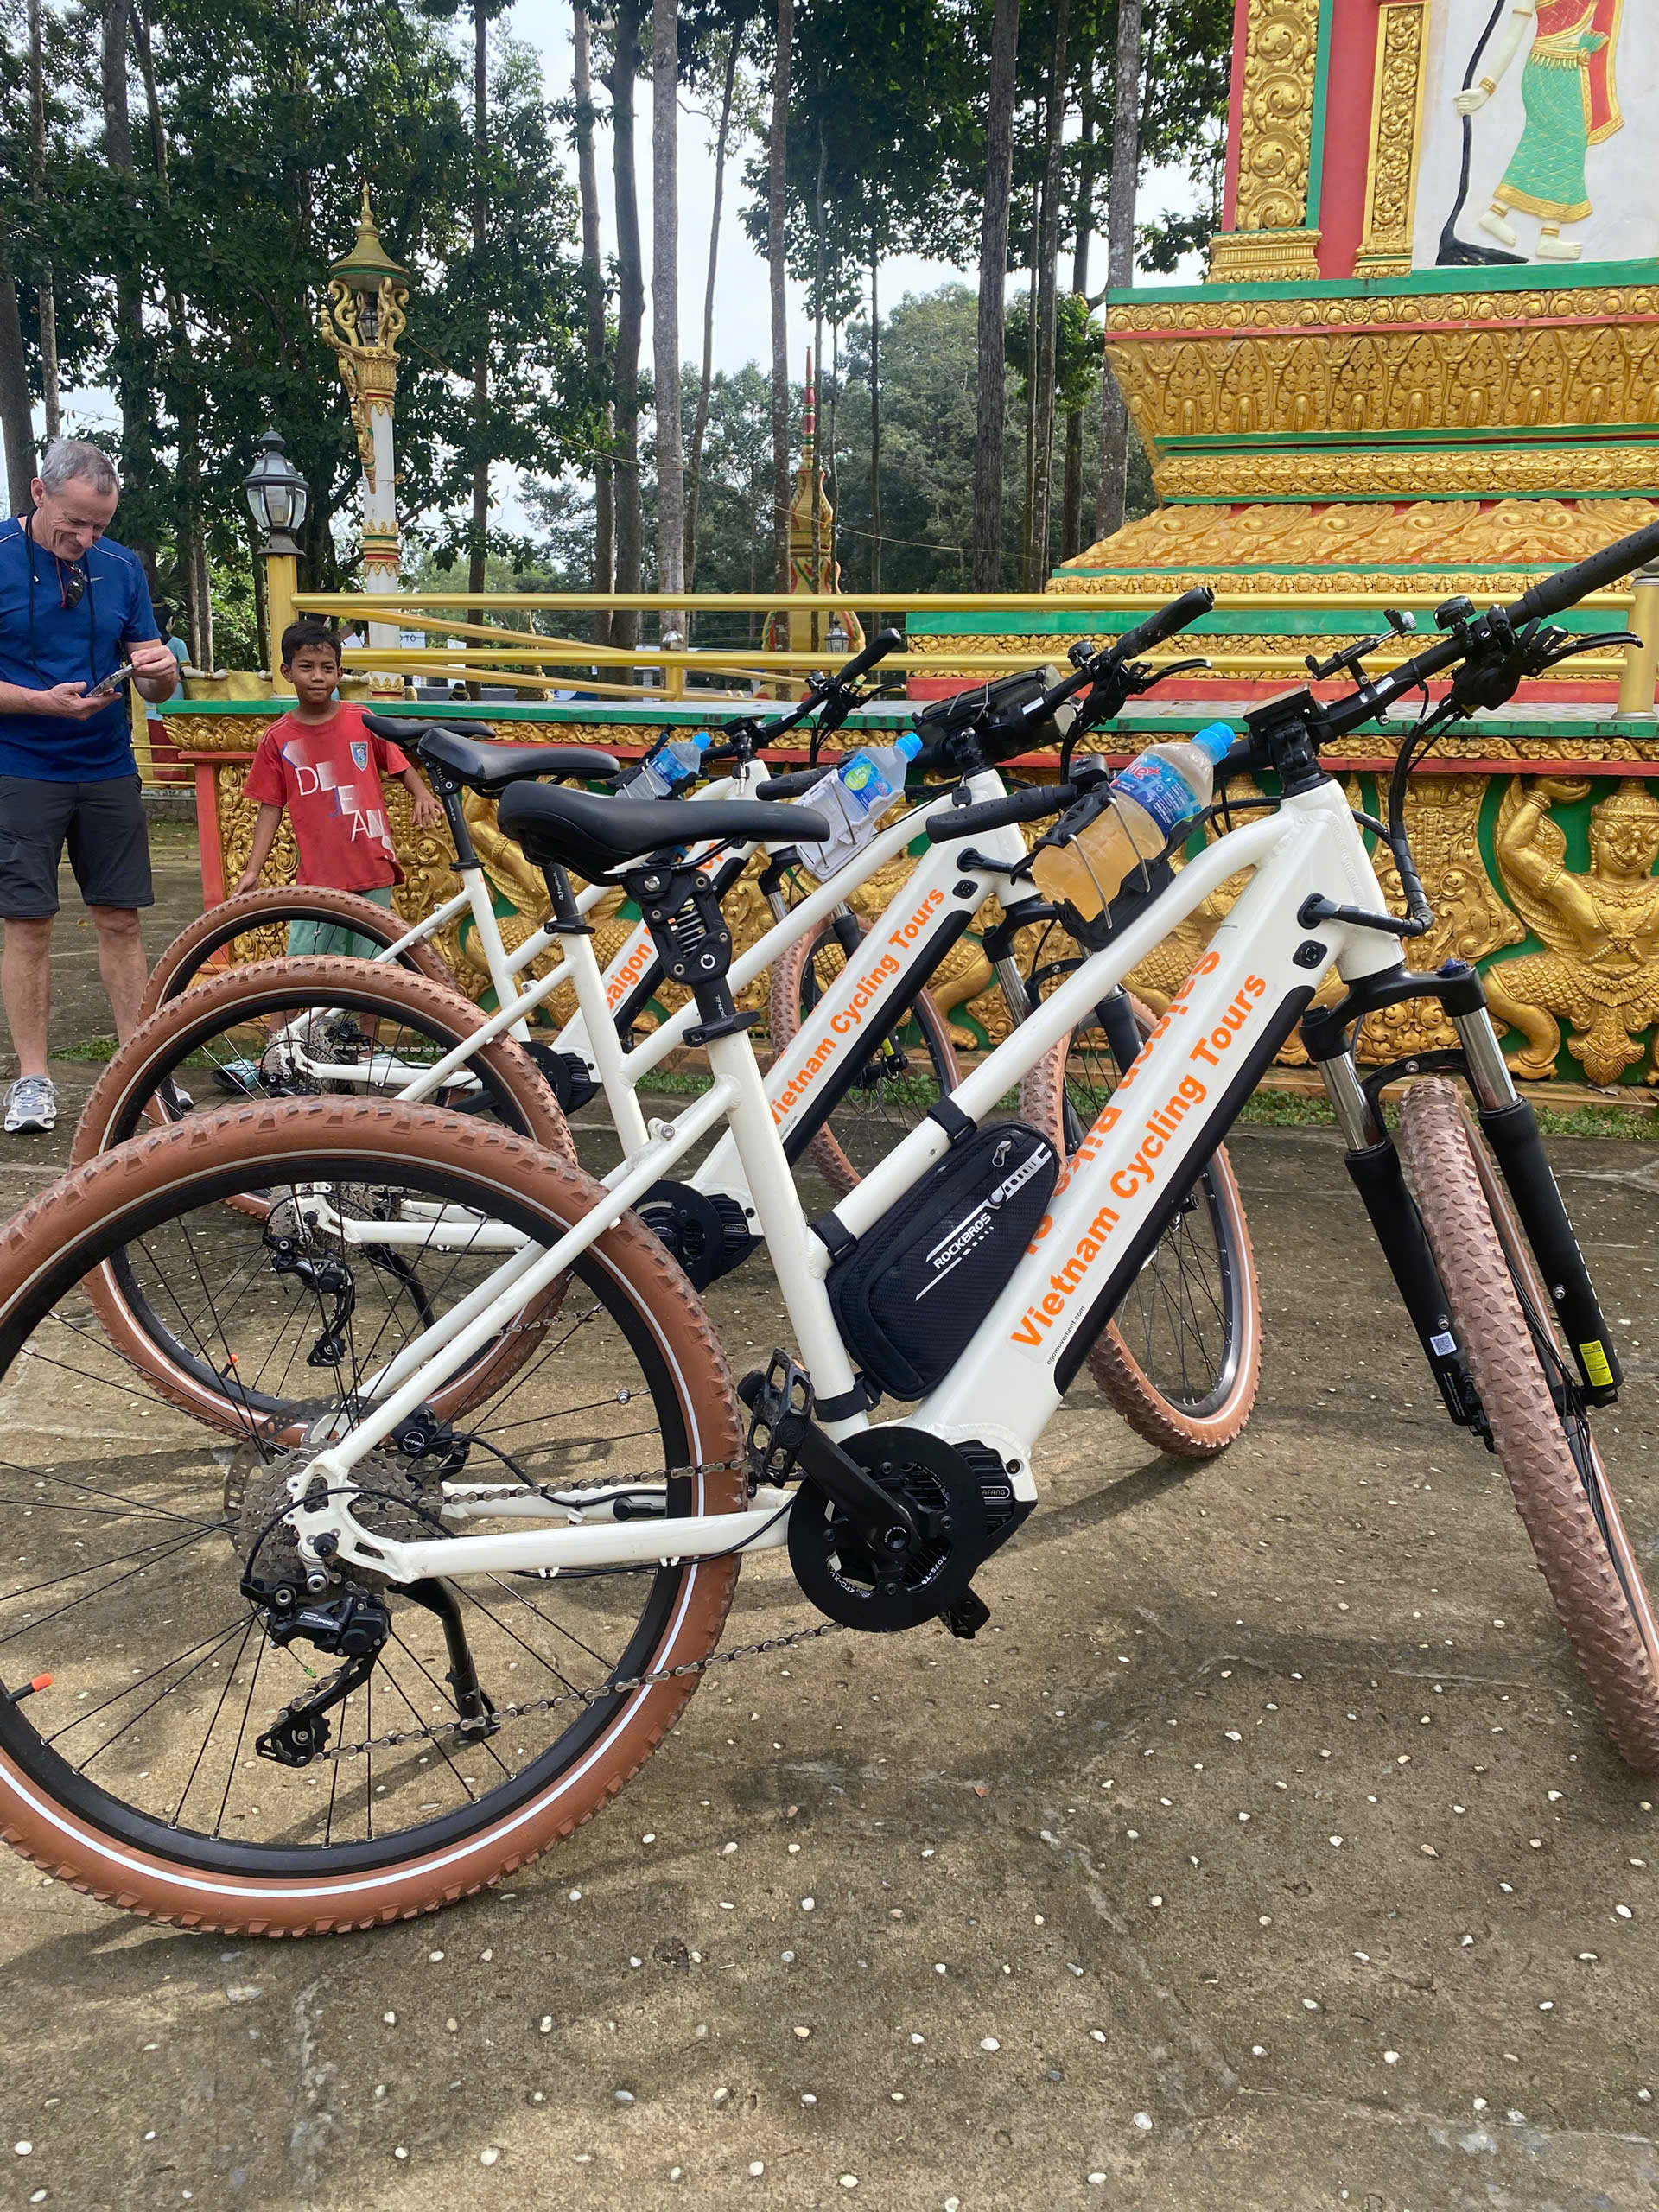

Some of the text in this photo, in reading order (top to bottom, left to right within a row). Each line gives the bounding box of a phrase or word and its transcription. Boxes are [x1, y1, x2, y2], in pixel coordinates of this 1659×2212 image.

[830, 953, 900, 1034] Cycling
[888, 888, 945, 950] Tours
[1010, 974, 1266, 1347] Vietnam Cycling Tours
[932, 1211, 993, 1272] ROCKBROS
[1046, 1306, 1086, 1365] egomovement.com
